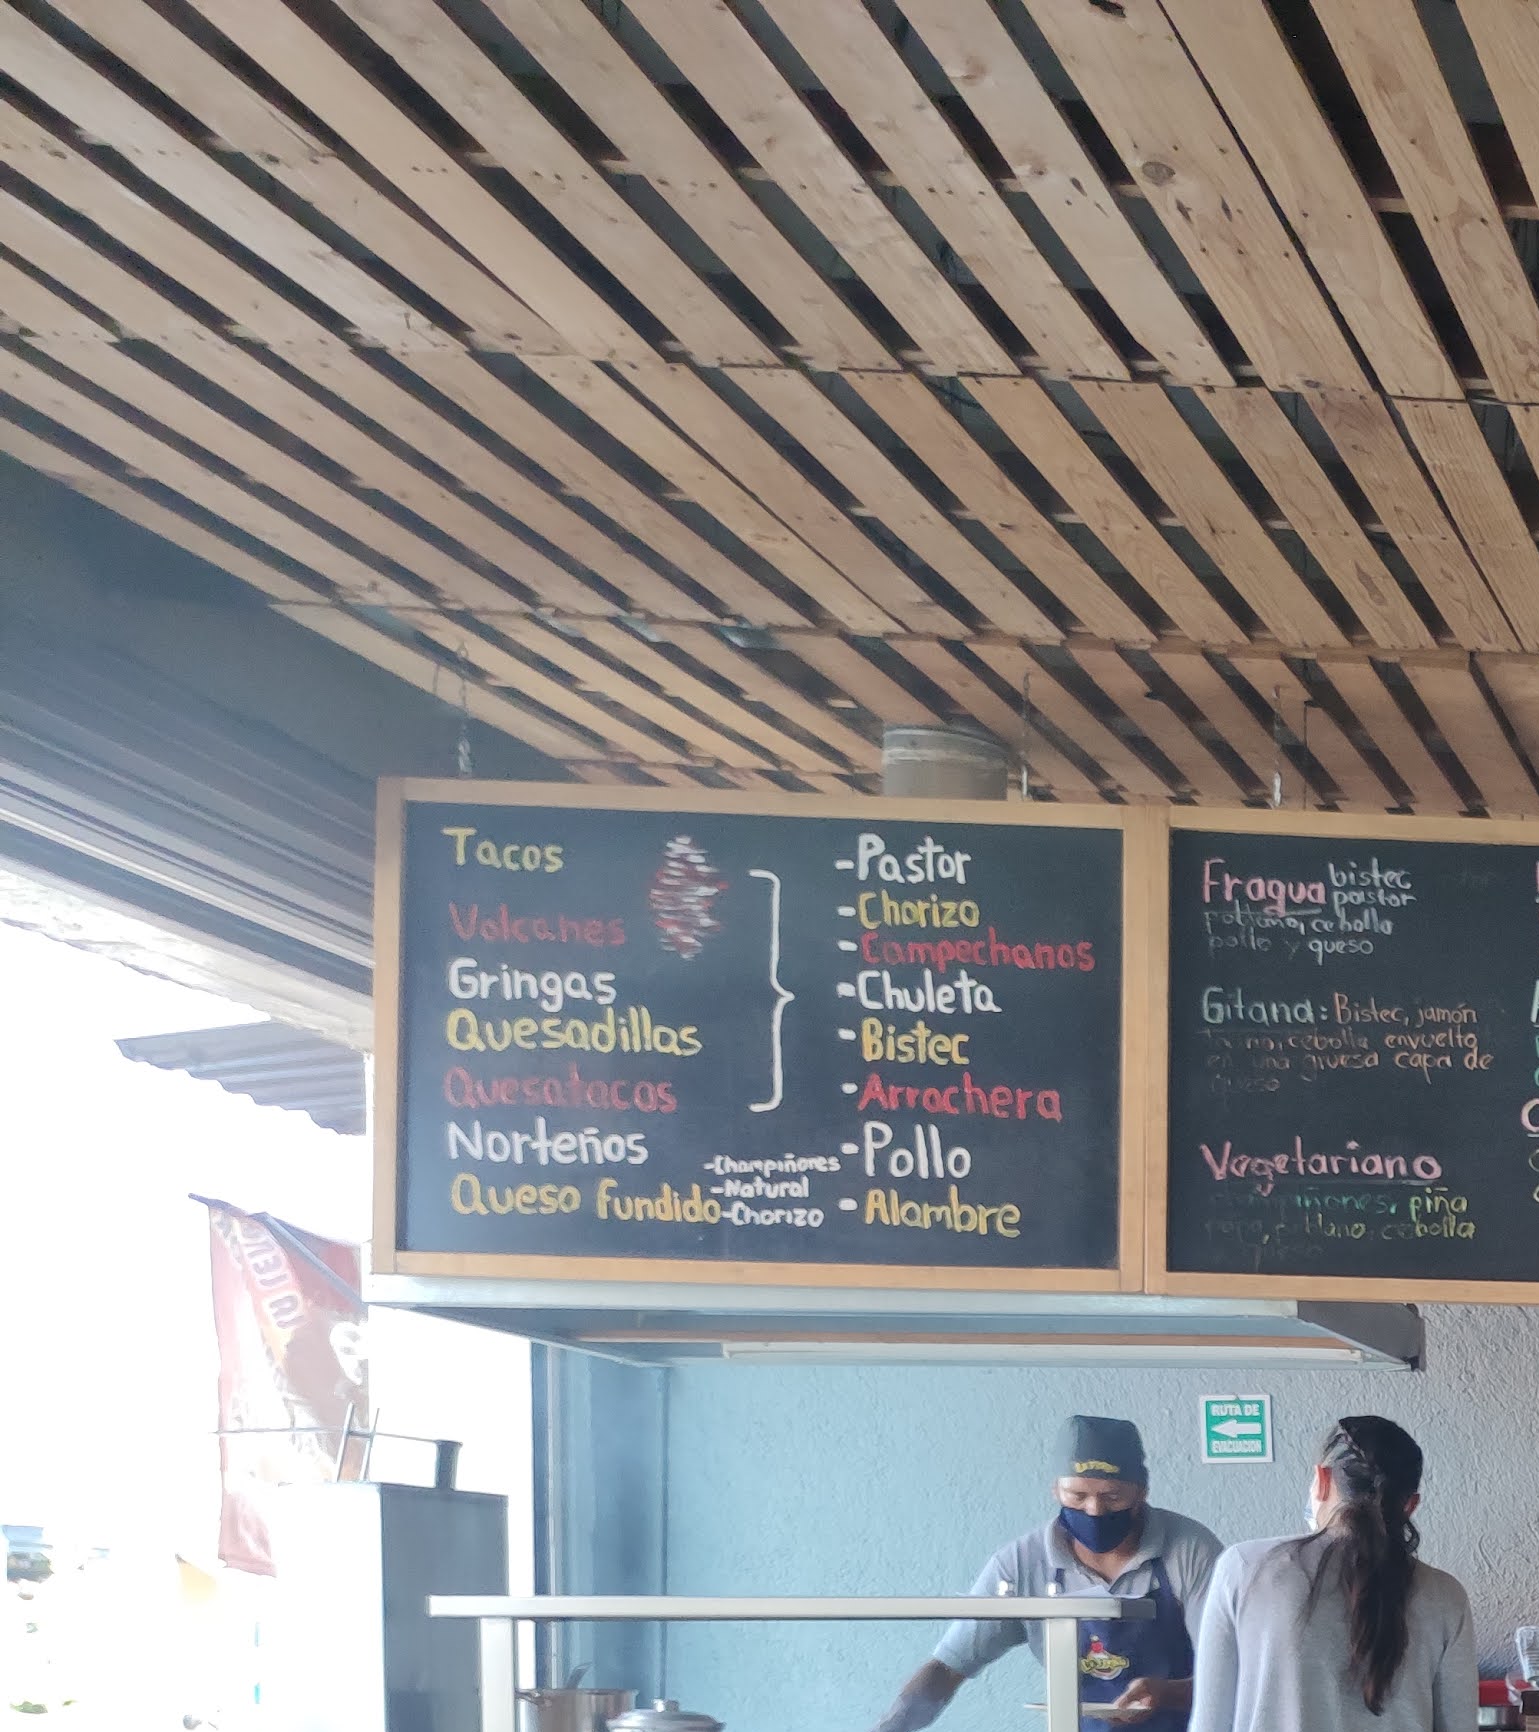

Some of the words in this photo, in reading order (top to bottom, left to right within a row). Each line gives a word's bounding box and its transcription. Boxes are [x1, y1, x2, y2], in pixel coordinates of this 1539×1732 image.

[442, 828, 564, 874] Tacos
[1203, 858, 1326, 917] Fragua
[449, 904, 625, 948] Volcanes
[1308, 938, 1374, 965] queso
[448, 958, 617, 1013] Gringas
[446, 1007, 702, 1057] Quesadillas
[1384, 1027, 1478, 1049] envuelto
[1464, 1048, 1494, 1070] de
[443, 1063, 677, 1114] Quesatacos
[448, 1118, 648, 1167] Norteños
[450, 1173, 581, 1216] Queso
[597, 1179, 722, 1225] fundido
[1211, 1403, 1242, 1416] RUTA
[1244, 1403, 1260, 1416] DE
